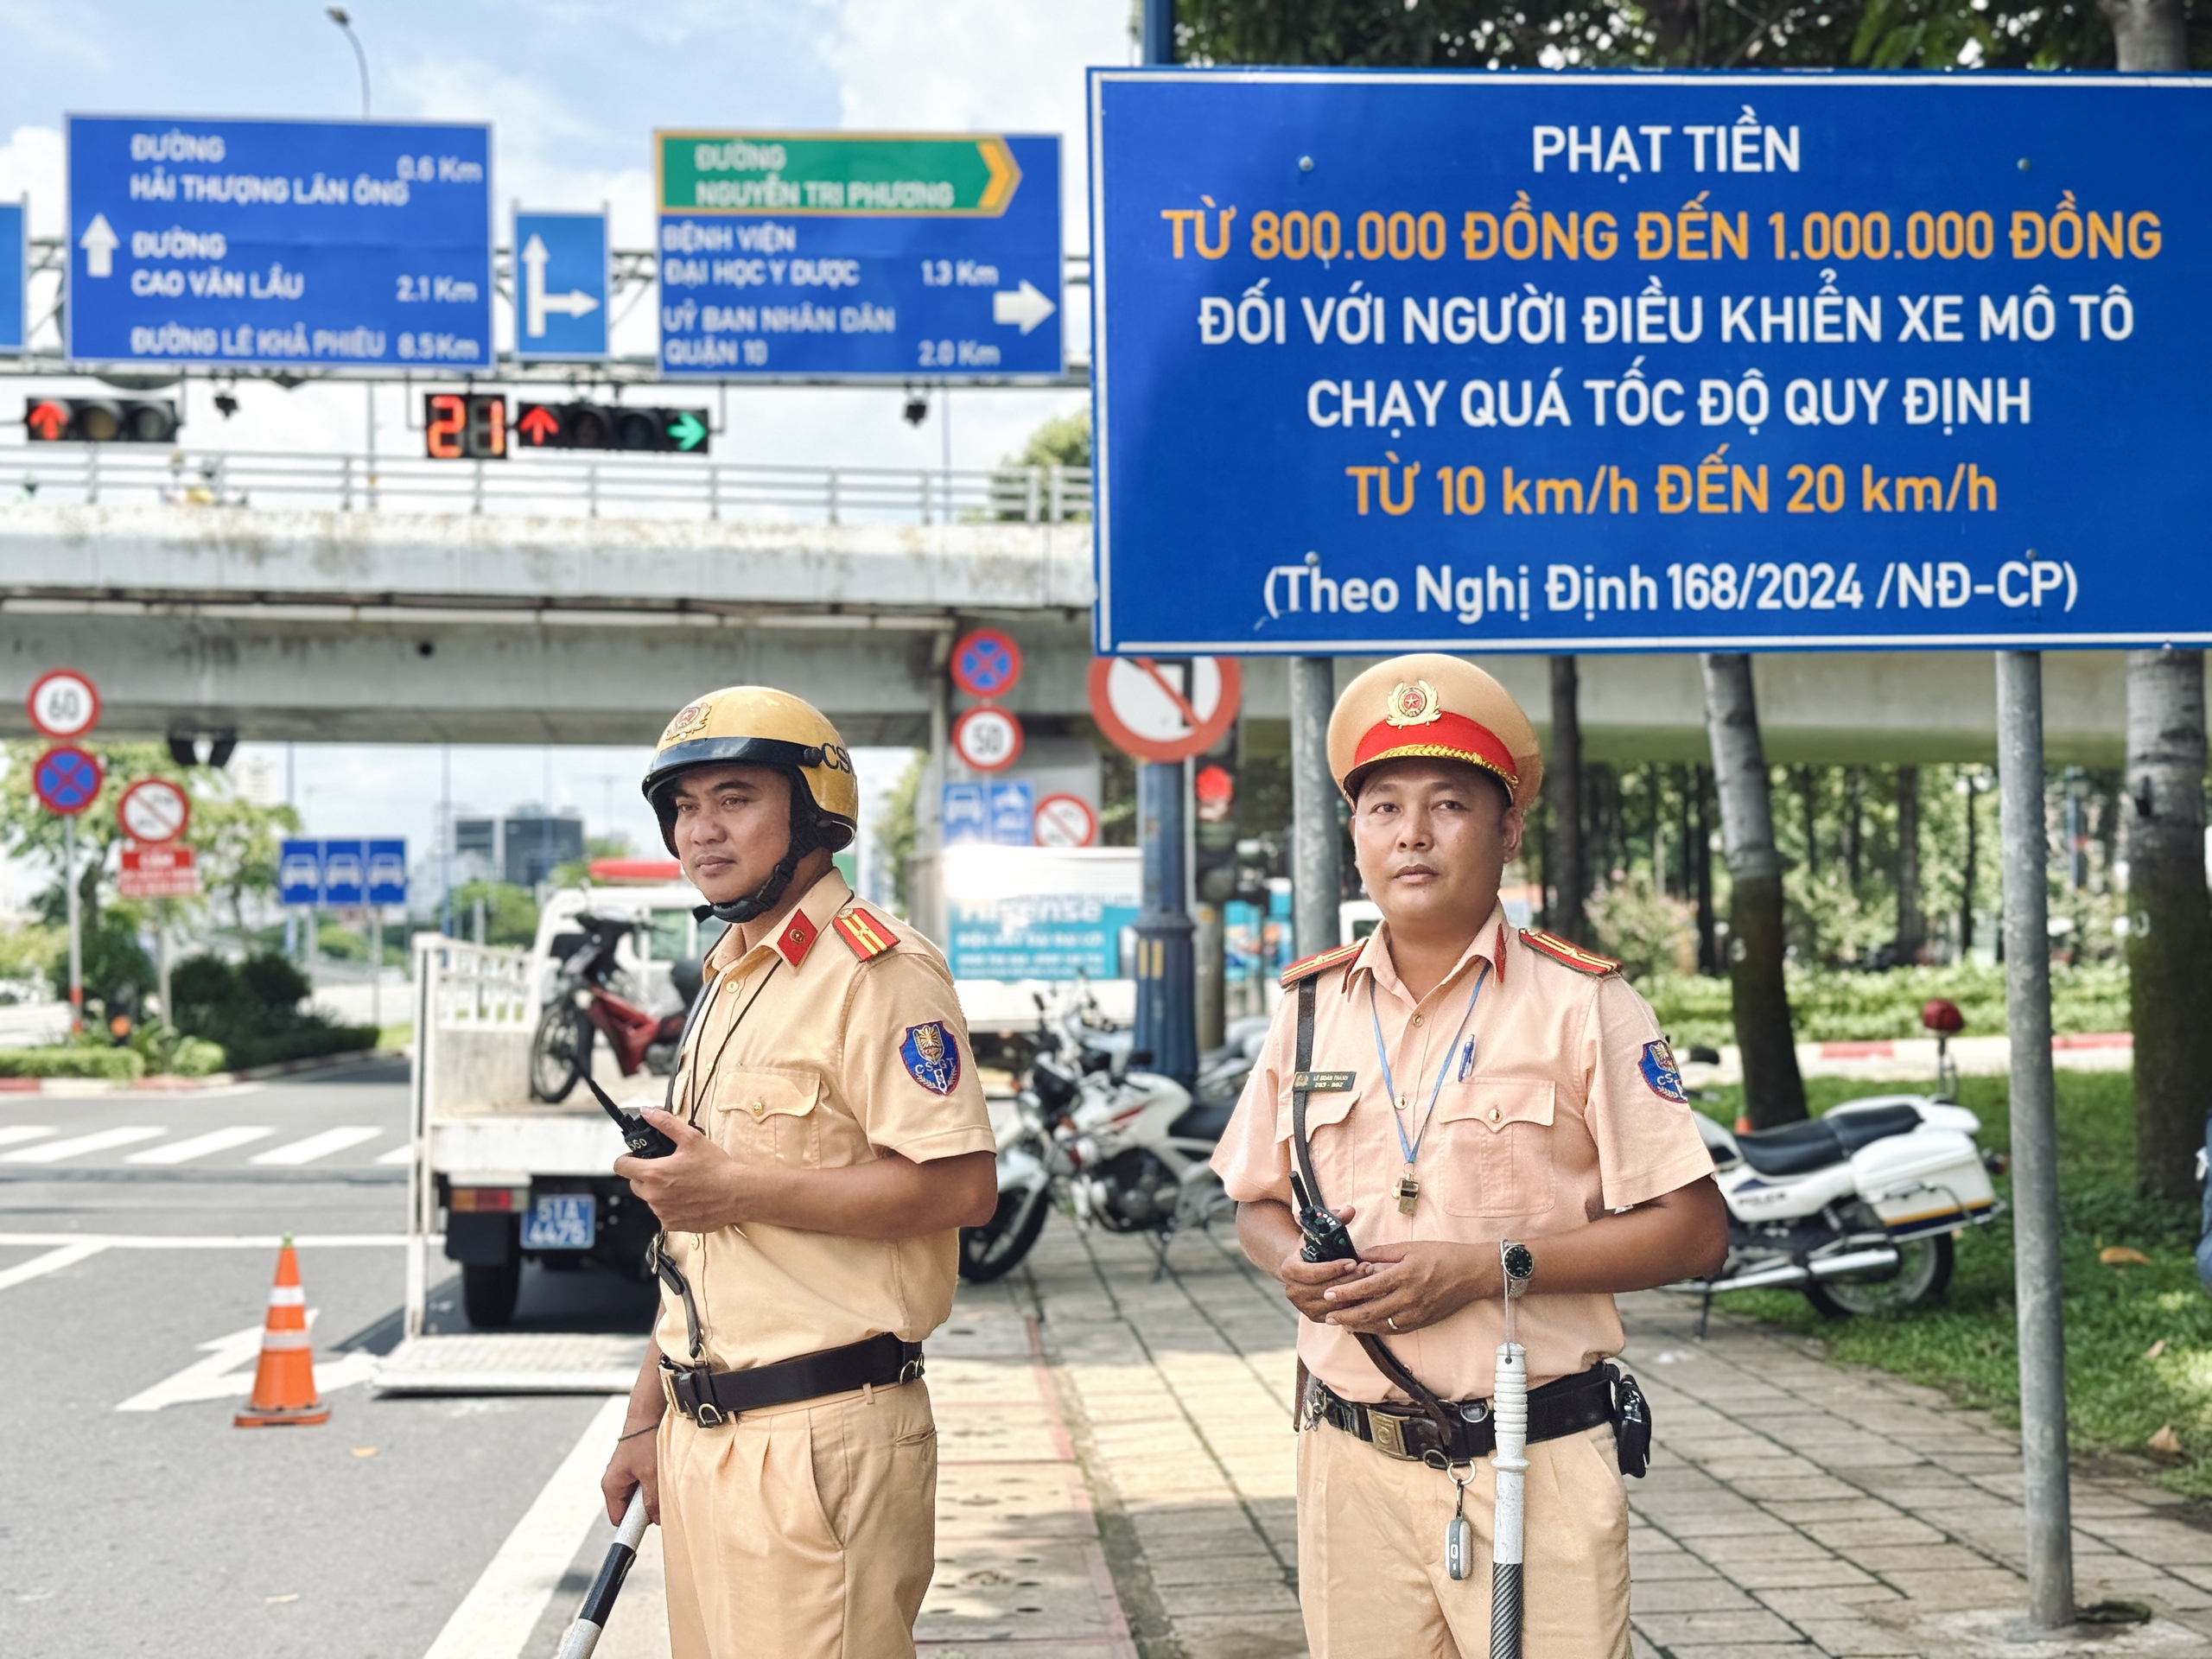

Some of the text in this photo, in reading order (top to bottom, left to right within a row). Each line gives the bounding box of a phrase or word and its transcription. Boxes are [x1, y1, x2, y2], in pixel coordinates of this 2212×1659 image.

[1533, 105, 1800, 182] PHẠT TIỀN
[439, 158, 483, 182] Km
[1160, 190, 2161, 261] TỪ 800.000 ĐỒNG ĐẾN 1.000.000 ĐỒNG
[130, 270, 185, 296] CAO
[769, 259, 786, 284] Y
[957, 261, 999, 286] Km
[397, 276, 478, 302] 2.1 Km
[702, 307, 757, 334] BAN
[1198, 268, 2133, 344] ĐỐI VỚI NGƯỜI ĐIỀU KHIỂN XE MÔ TÔ
[957, 342, 1001, 366] Km
[1307, 356, 2030, 438] CHẠY QUÁ TỐC ĐỘ QUY ĐỊNH
[428, 395, 505, 459] 21
[1345, 443, 1997, 515] TỪ 10 km/h ĐẾN 20 km/h
[1264, 561, 2077, 624] (Theo Nghị Định 168/2024 /NĐ-CP)
[972, 722, 1004, 754] 50
[821, 742, 850, 774] CS
